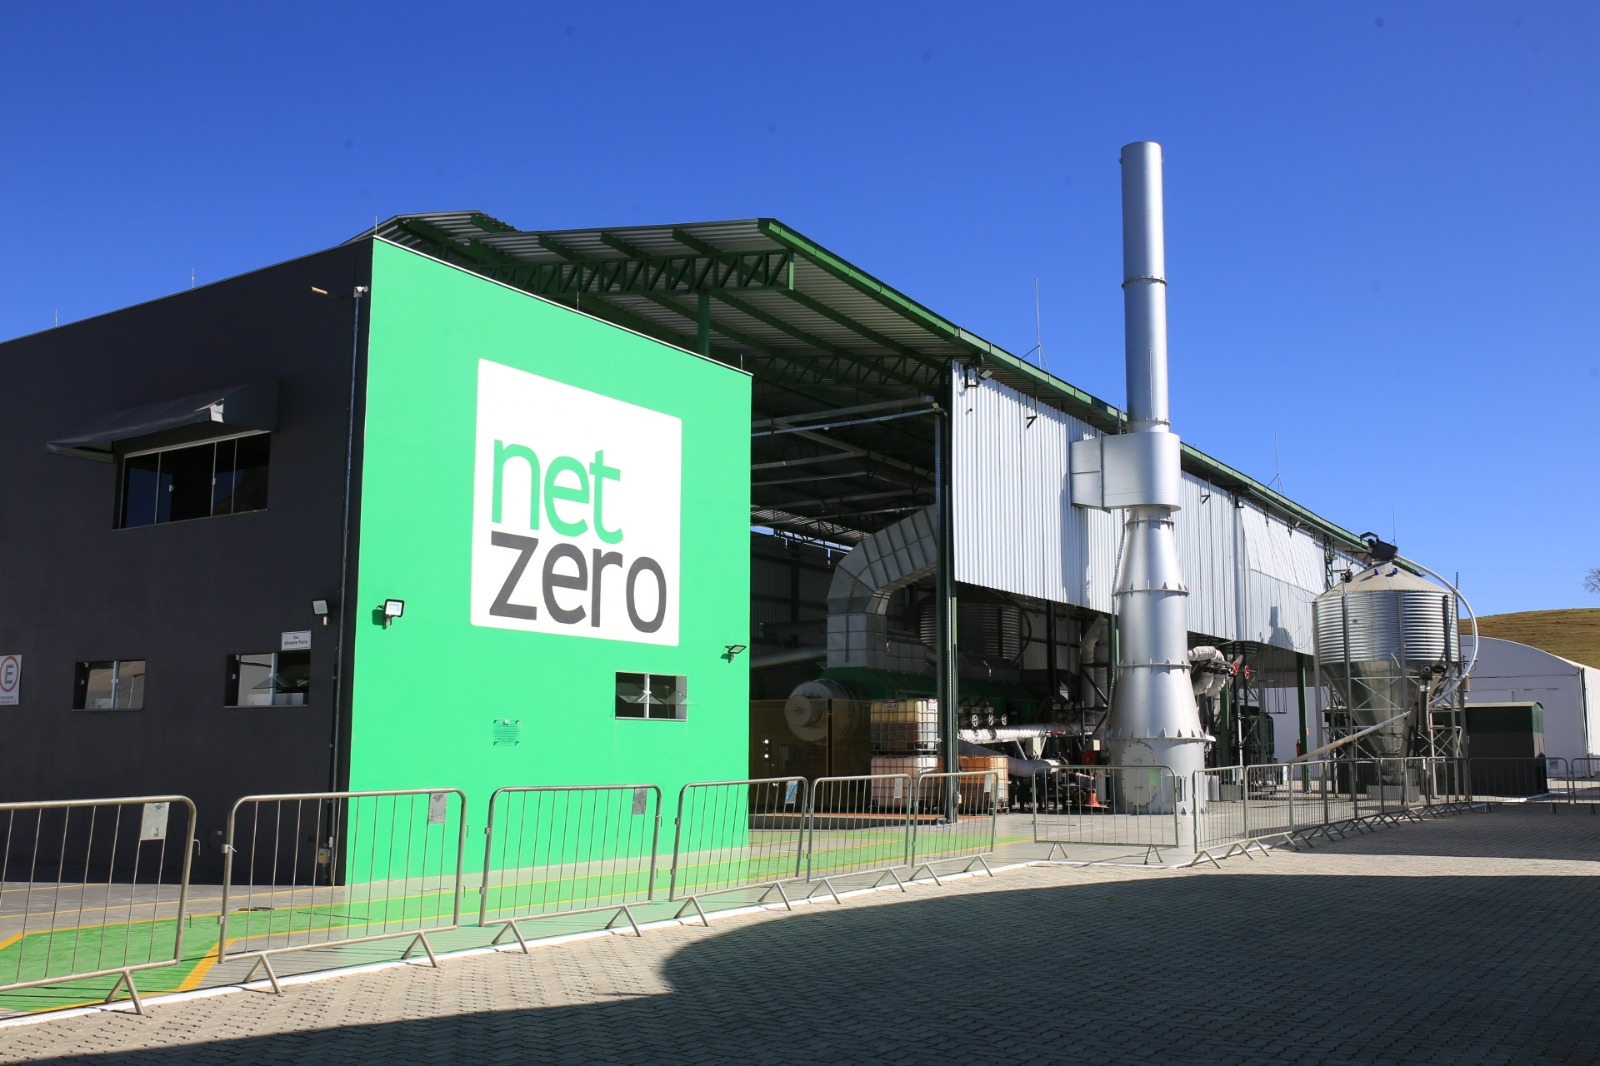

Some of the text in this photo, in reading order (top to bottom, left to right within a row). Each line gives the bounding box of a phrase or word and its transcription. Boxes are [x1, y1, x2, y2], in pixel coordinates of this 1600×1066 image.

[492, 439, 624, 544] net
[489, 530, 667, 633] zero
[5, 665, 14, 684] E
